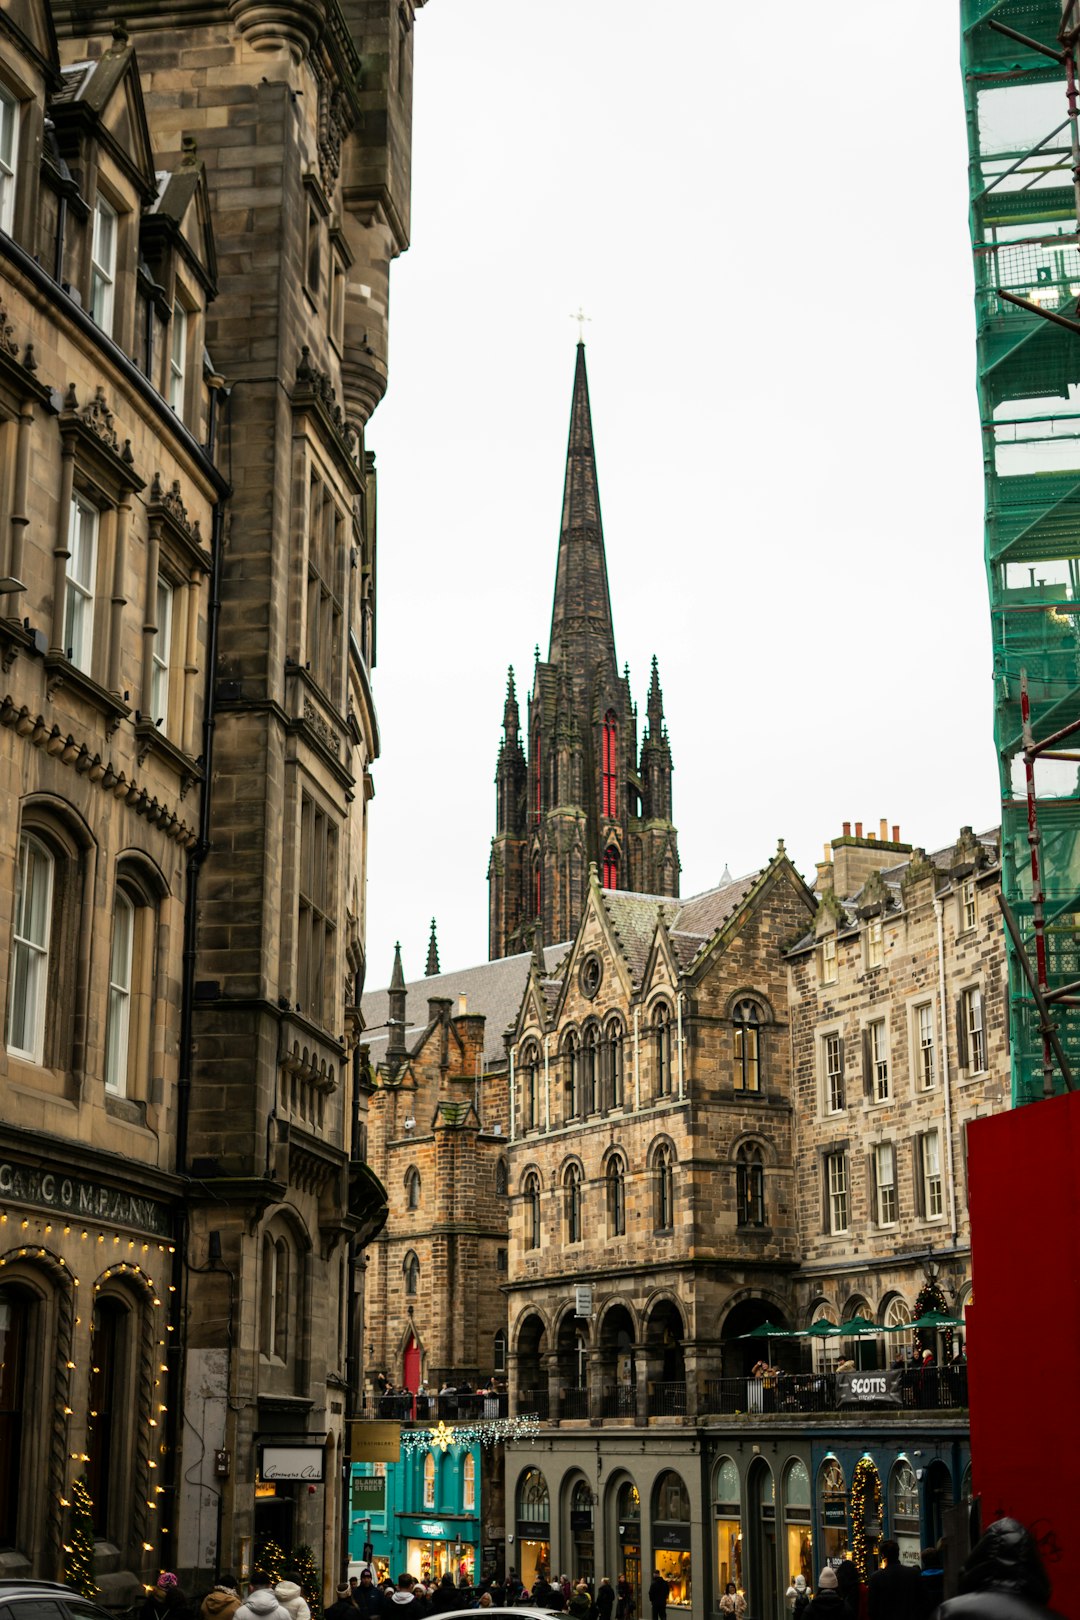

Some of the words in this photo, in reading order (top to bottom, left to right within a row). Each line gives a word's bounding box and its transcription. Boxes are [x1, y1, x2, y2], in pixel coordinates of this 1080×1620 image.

[41, 1174, 157, 1228] COMPANY
[851, 1378, 886, 1393] SCOTTS
[300, 1466, 321, 1478] Club
[902, 1551, 920, 1560] HOWIES
